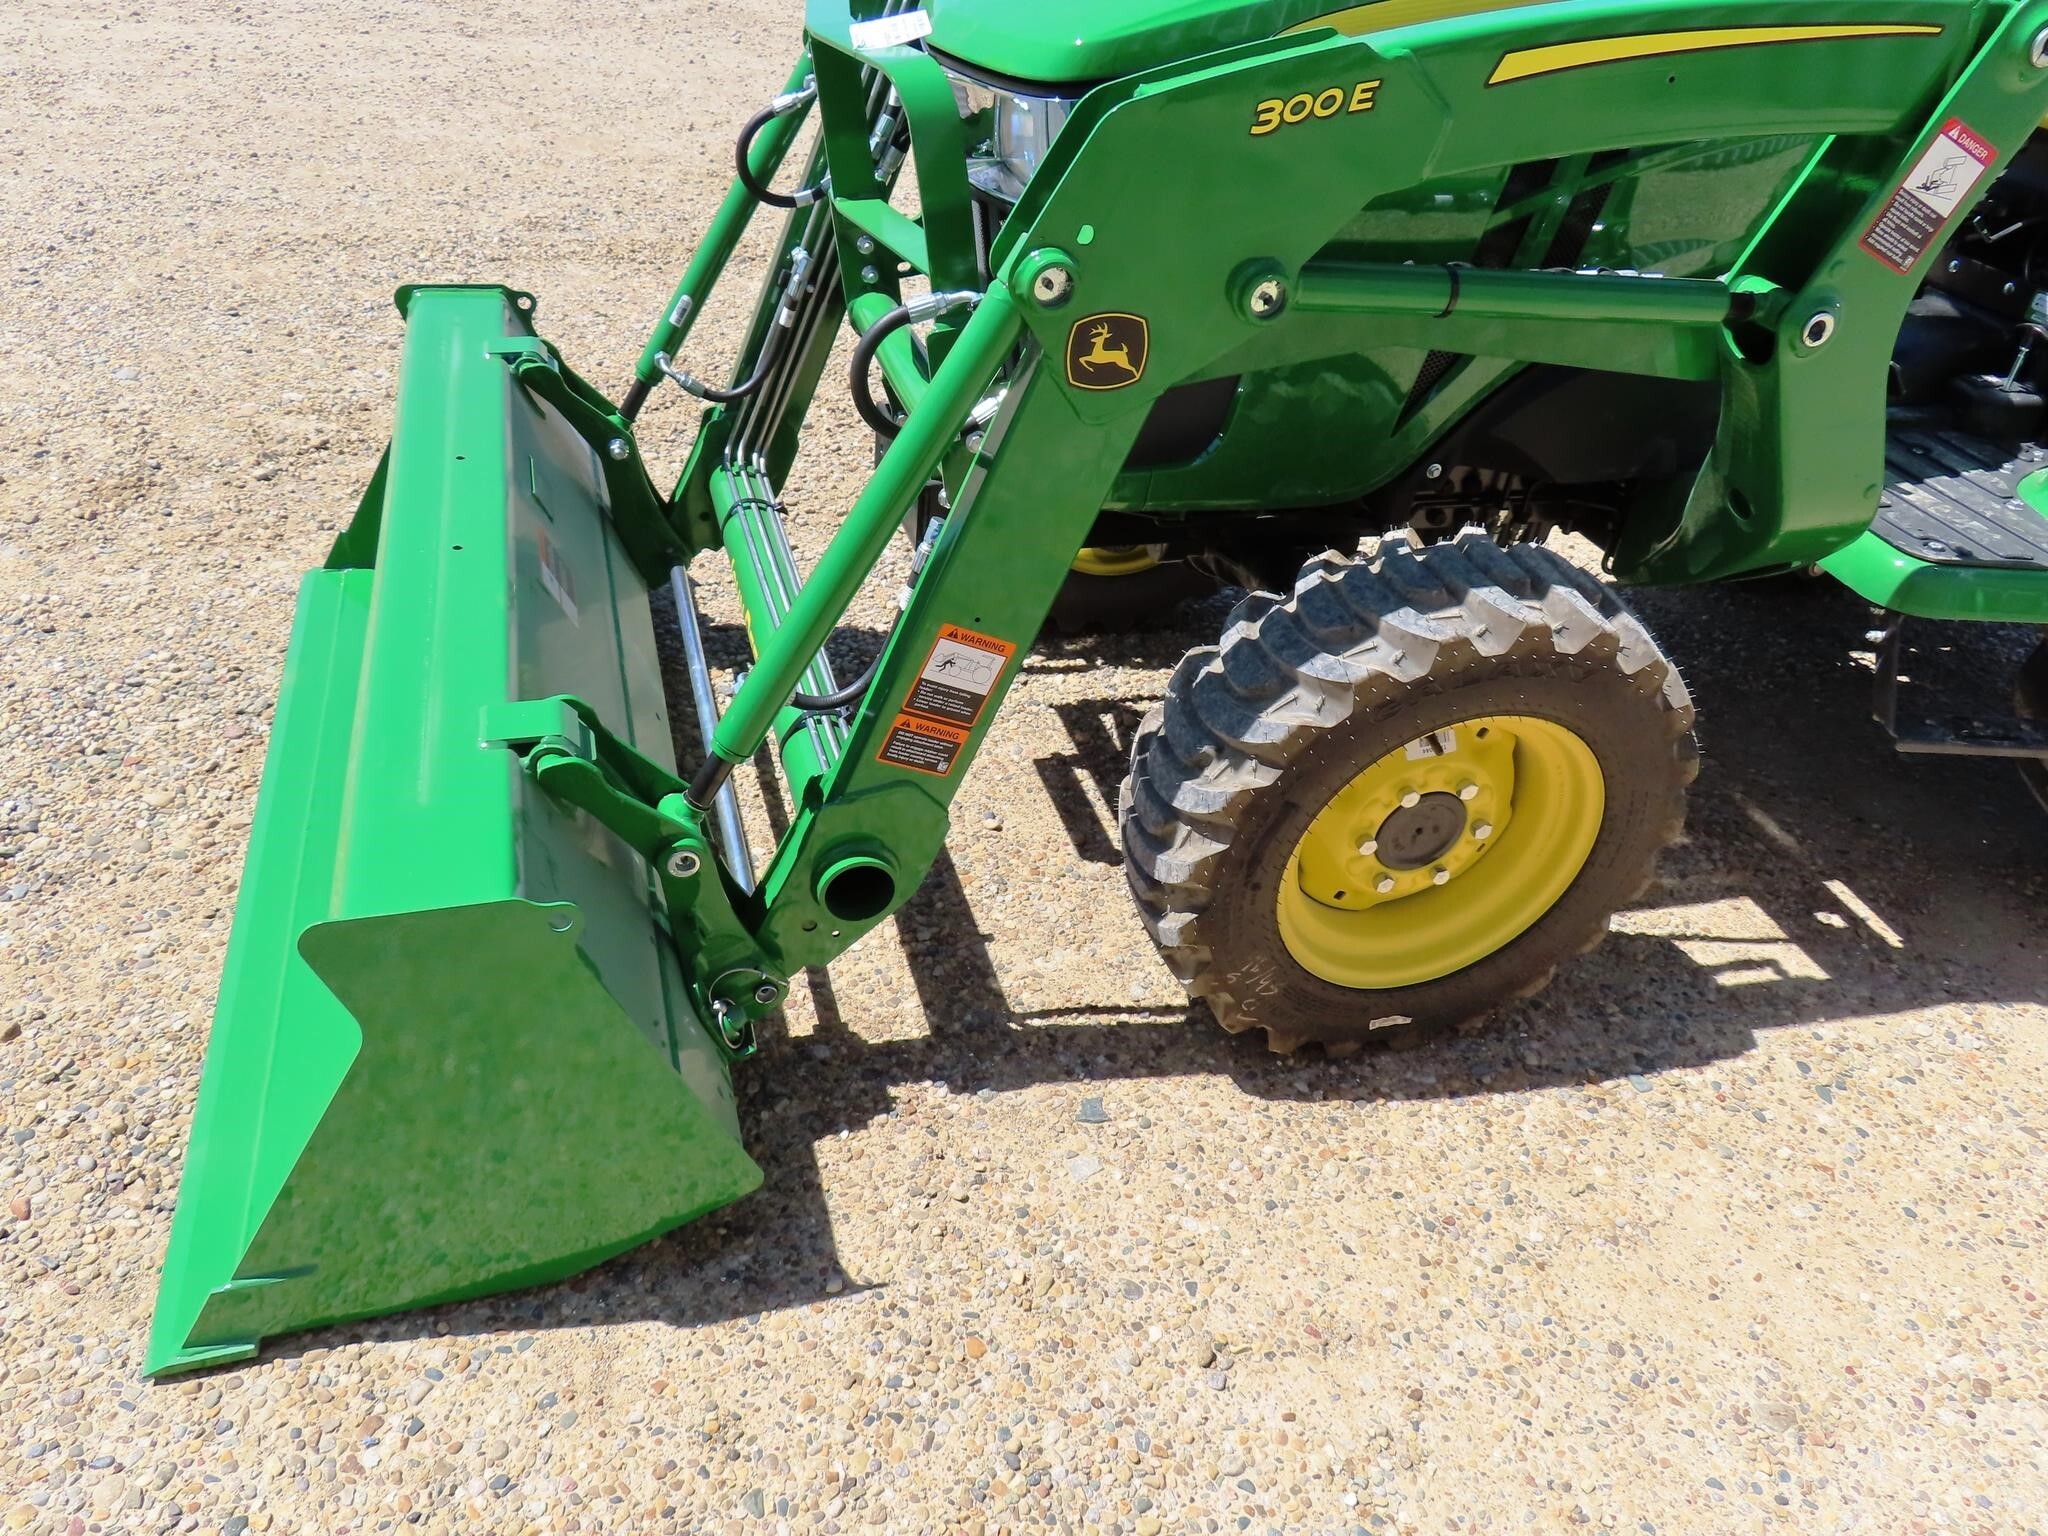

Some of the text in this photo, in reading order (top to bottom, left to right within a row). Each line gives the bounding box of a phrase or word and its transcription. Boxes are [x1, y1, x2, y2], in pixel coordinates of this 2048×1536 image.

[1249, 79, 1381, 135] 300E
[1958, 133, 1989, 160] DANGER
[960, 632, 1006, 653] WARNING
[915, 722, 960, 741] WARNING
